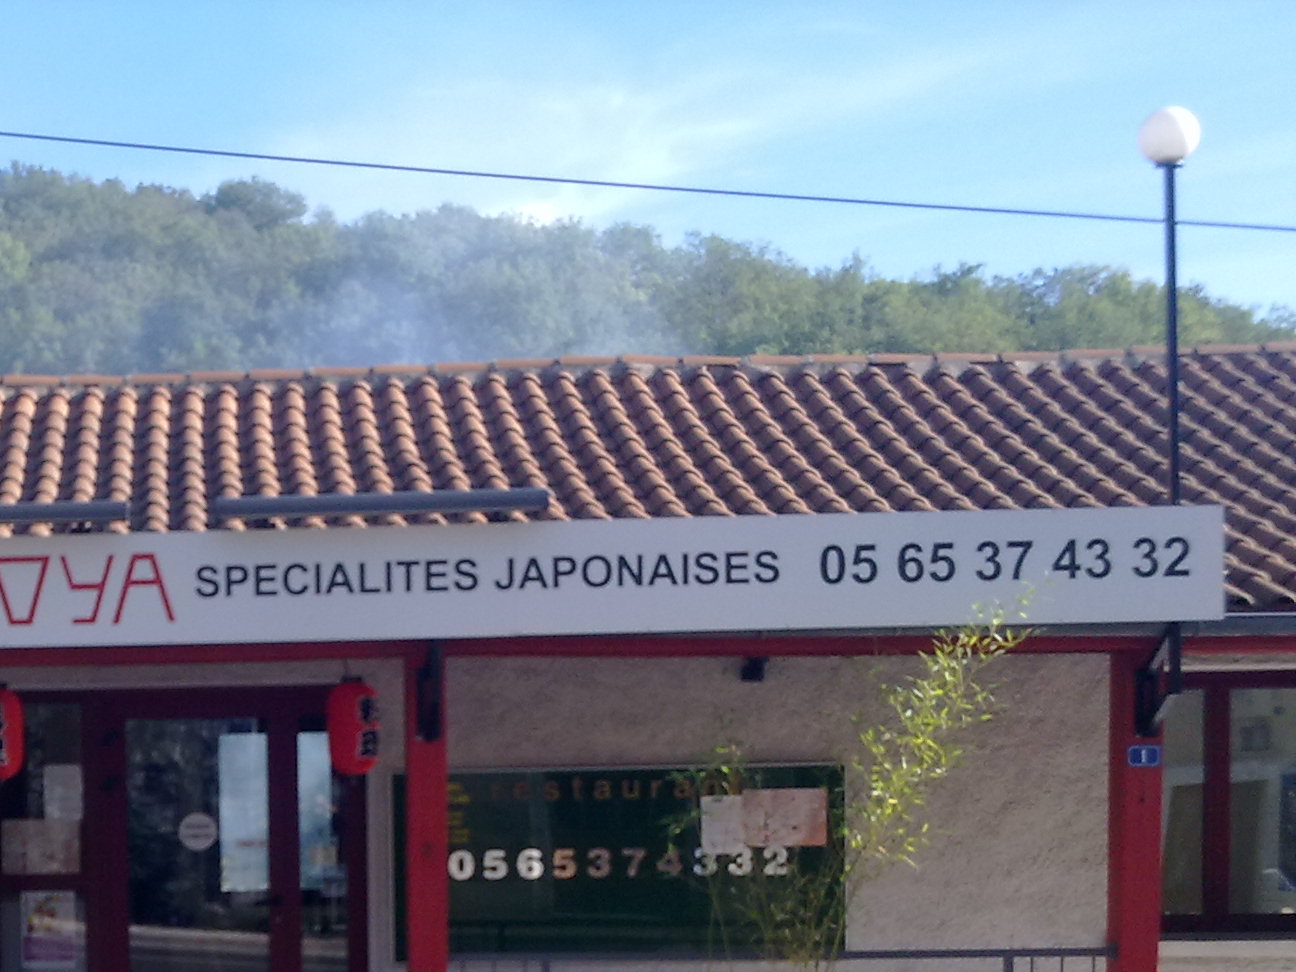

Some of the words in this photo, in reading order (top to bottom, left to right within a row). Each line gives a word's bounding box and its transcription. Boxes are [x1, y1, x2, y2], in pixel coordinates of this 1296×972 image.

[194, 557, 480, 599] SPECIALITES
[493, 549, 781, 592] JAPONAISES
[818, 543, 879, 586] 05
[896, 541, 957, 584] 65
[974, 539, 1035, 583] 37
[1051, 537, 1113, 580] 43
[1131, 535, 1191, 579] 32
